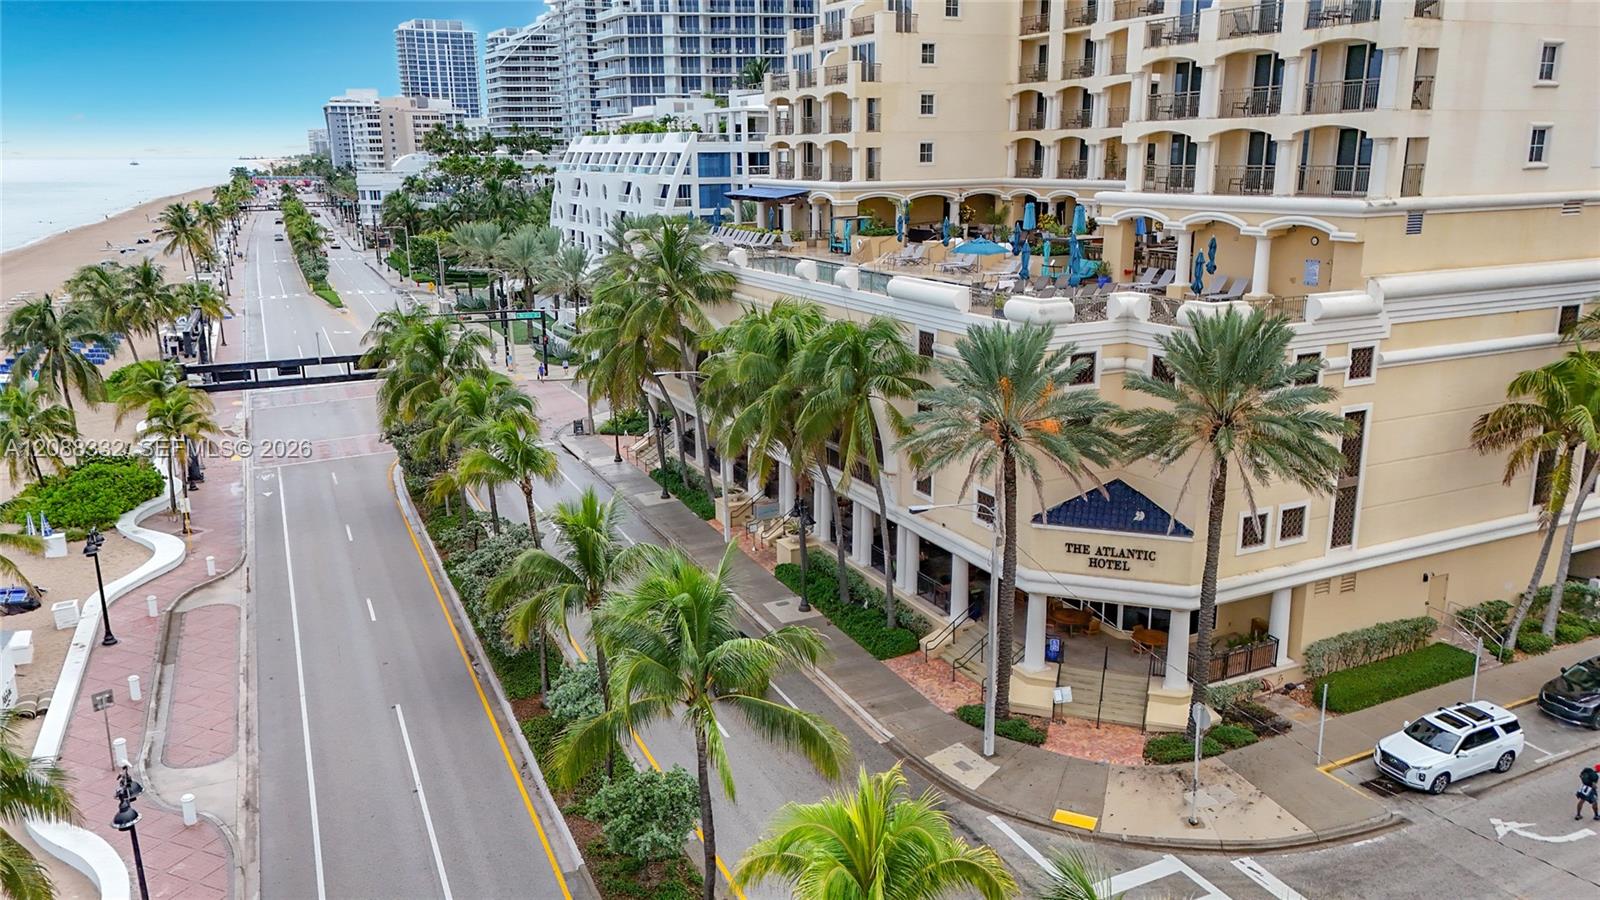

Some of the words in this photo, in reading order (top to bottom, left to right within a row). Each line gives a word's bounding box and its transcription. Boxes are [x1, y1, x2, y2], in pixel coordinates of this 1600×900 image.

[1065, 542, 1090, 555] THE
[1095, 546, 1156, 562] ATLANTIC
[1088, 557, 1131, 571] HOTEL
